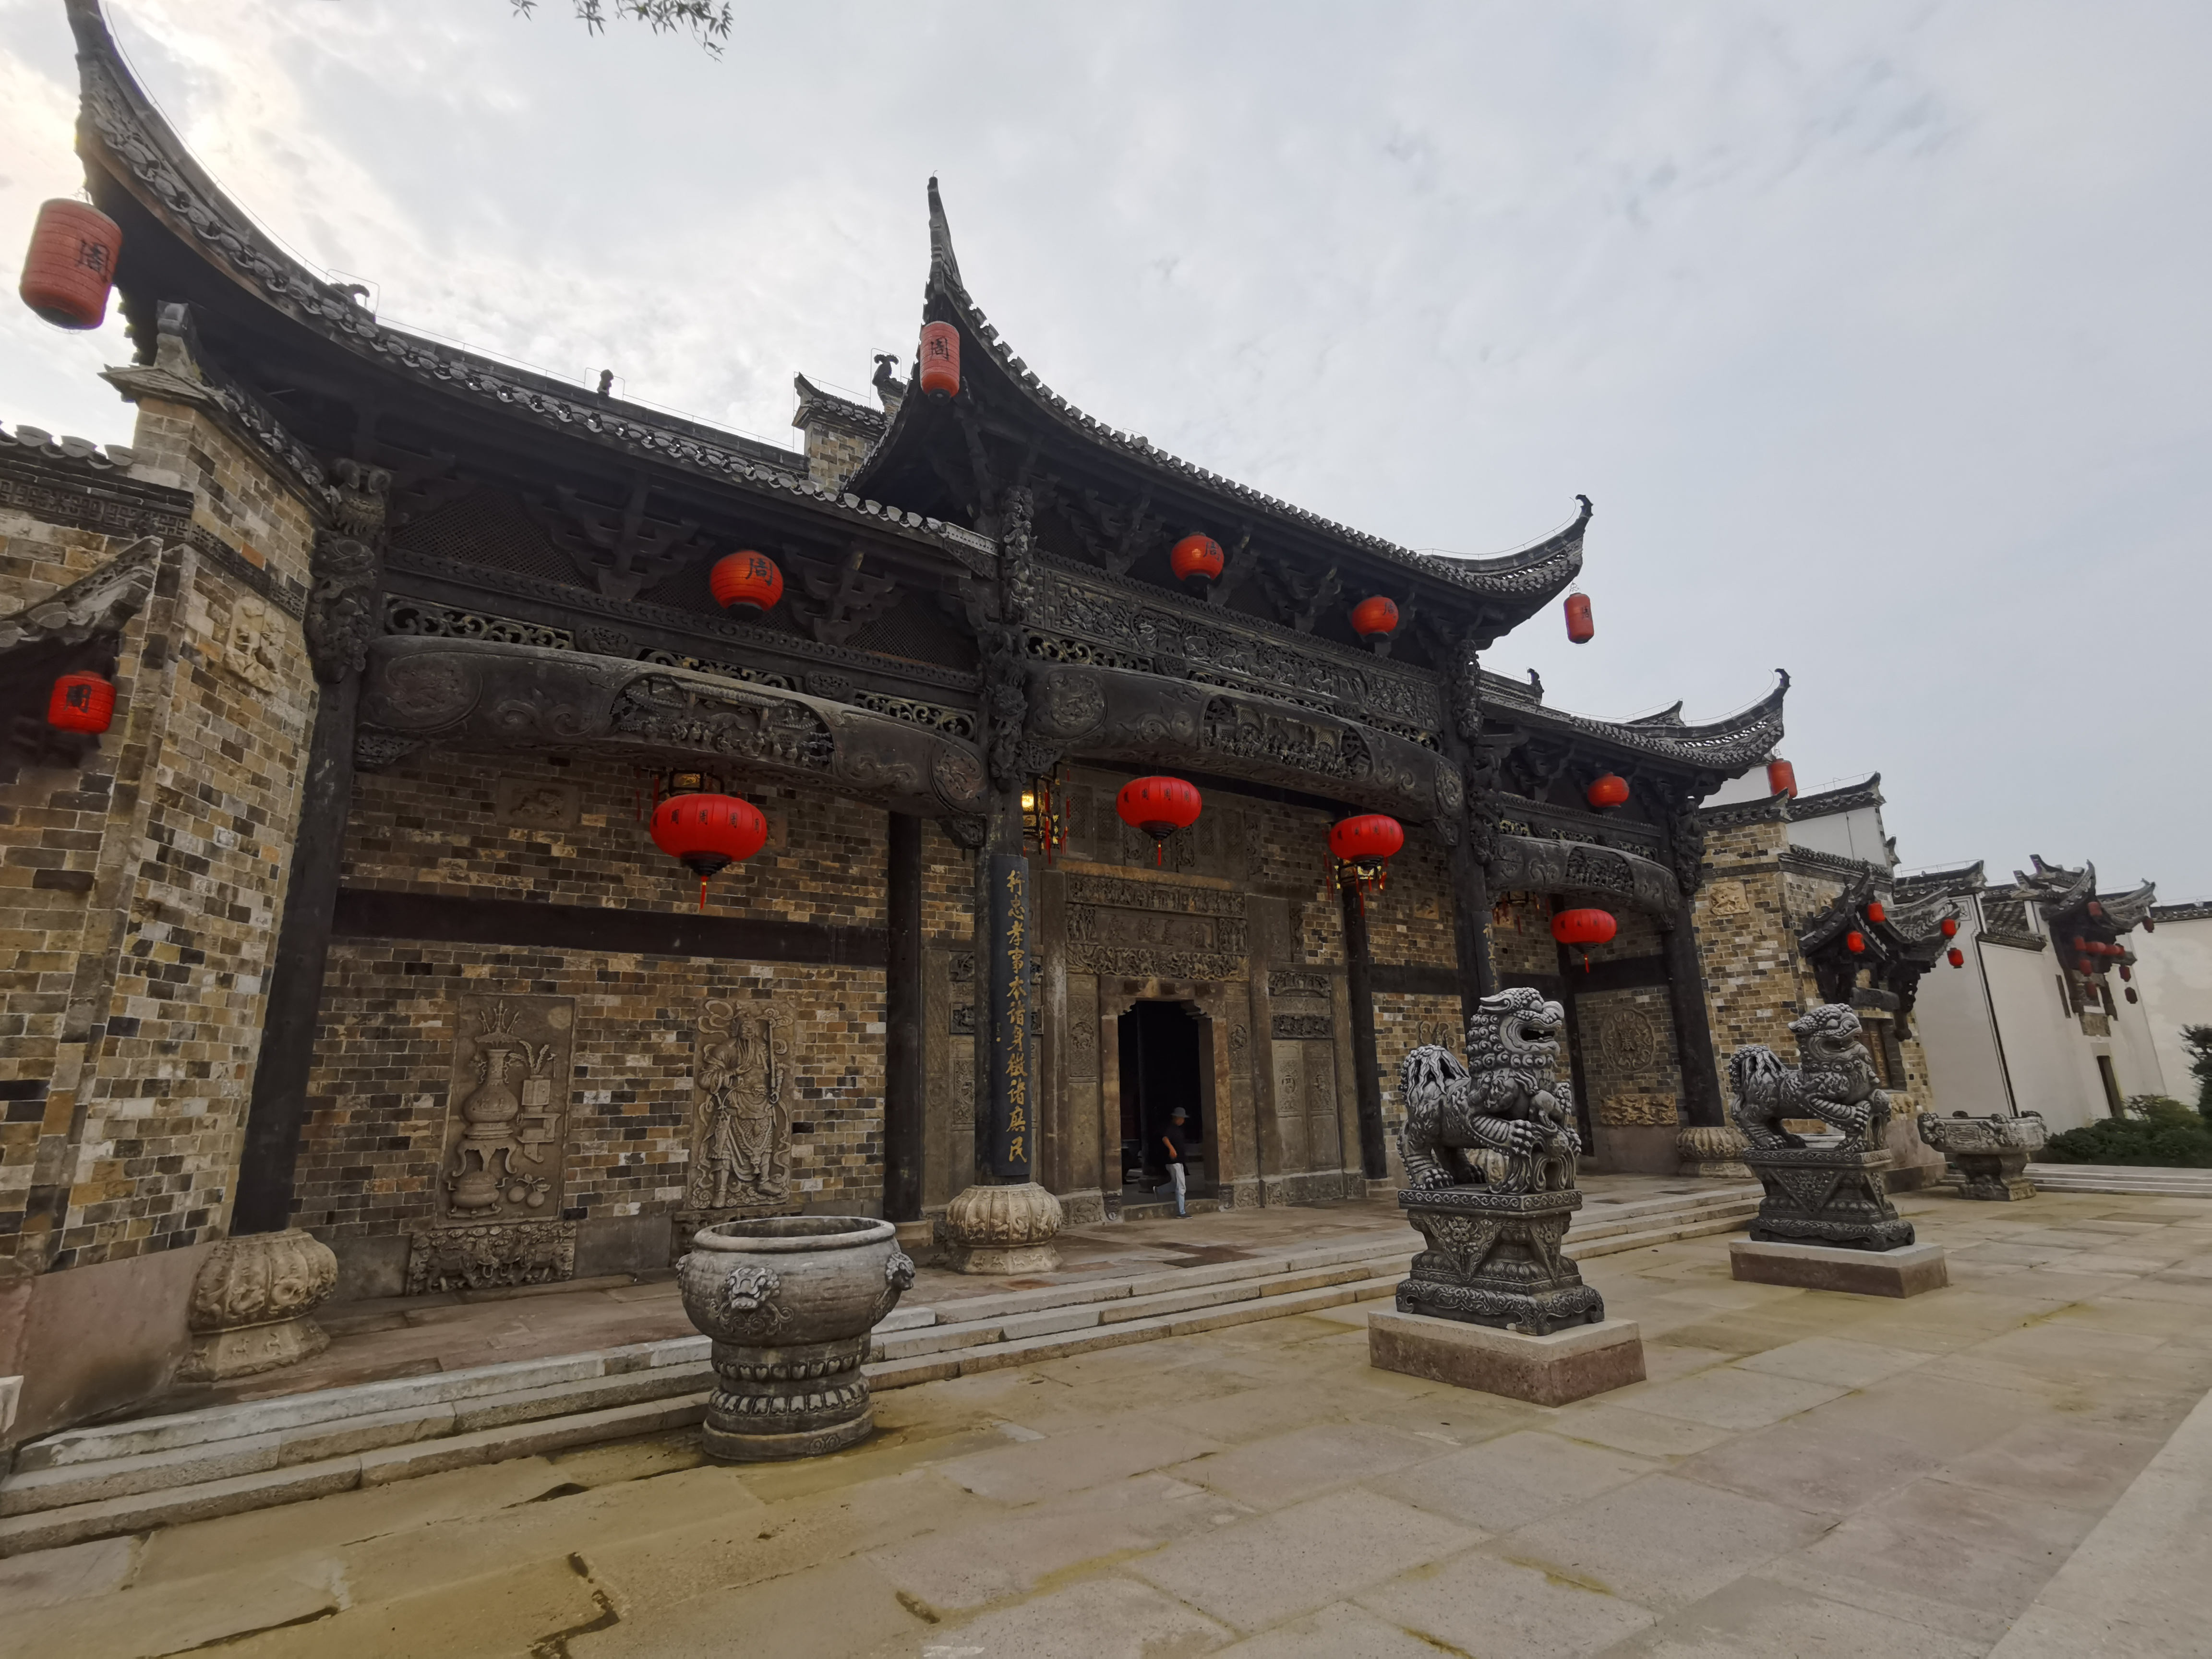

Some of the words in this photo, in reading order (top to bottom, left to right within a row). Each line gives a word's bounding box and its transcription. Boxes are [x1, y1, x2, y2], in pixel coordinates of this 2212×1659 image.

[79, 239, 110, 283] 周
[930, 337, 949, 361] 周
[1203, 541, 1222, 562] 周
[745, 558, 773, 586] 周
[698, 809, 709, 825] 周
